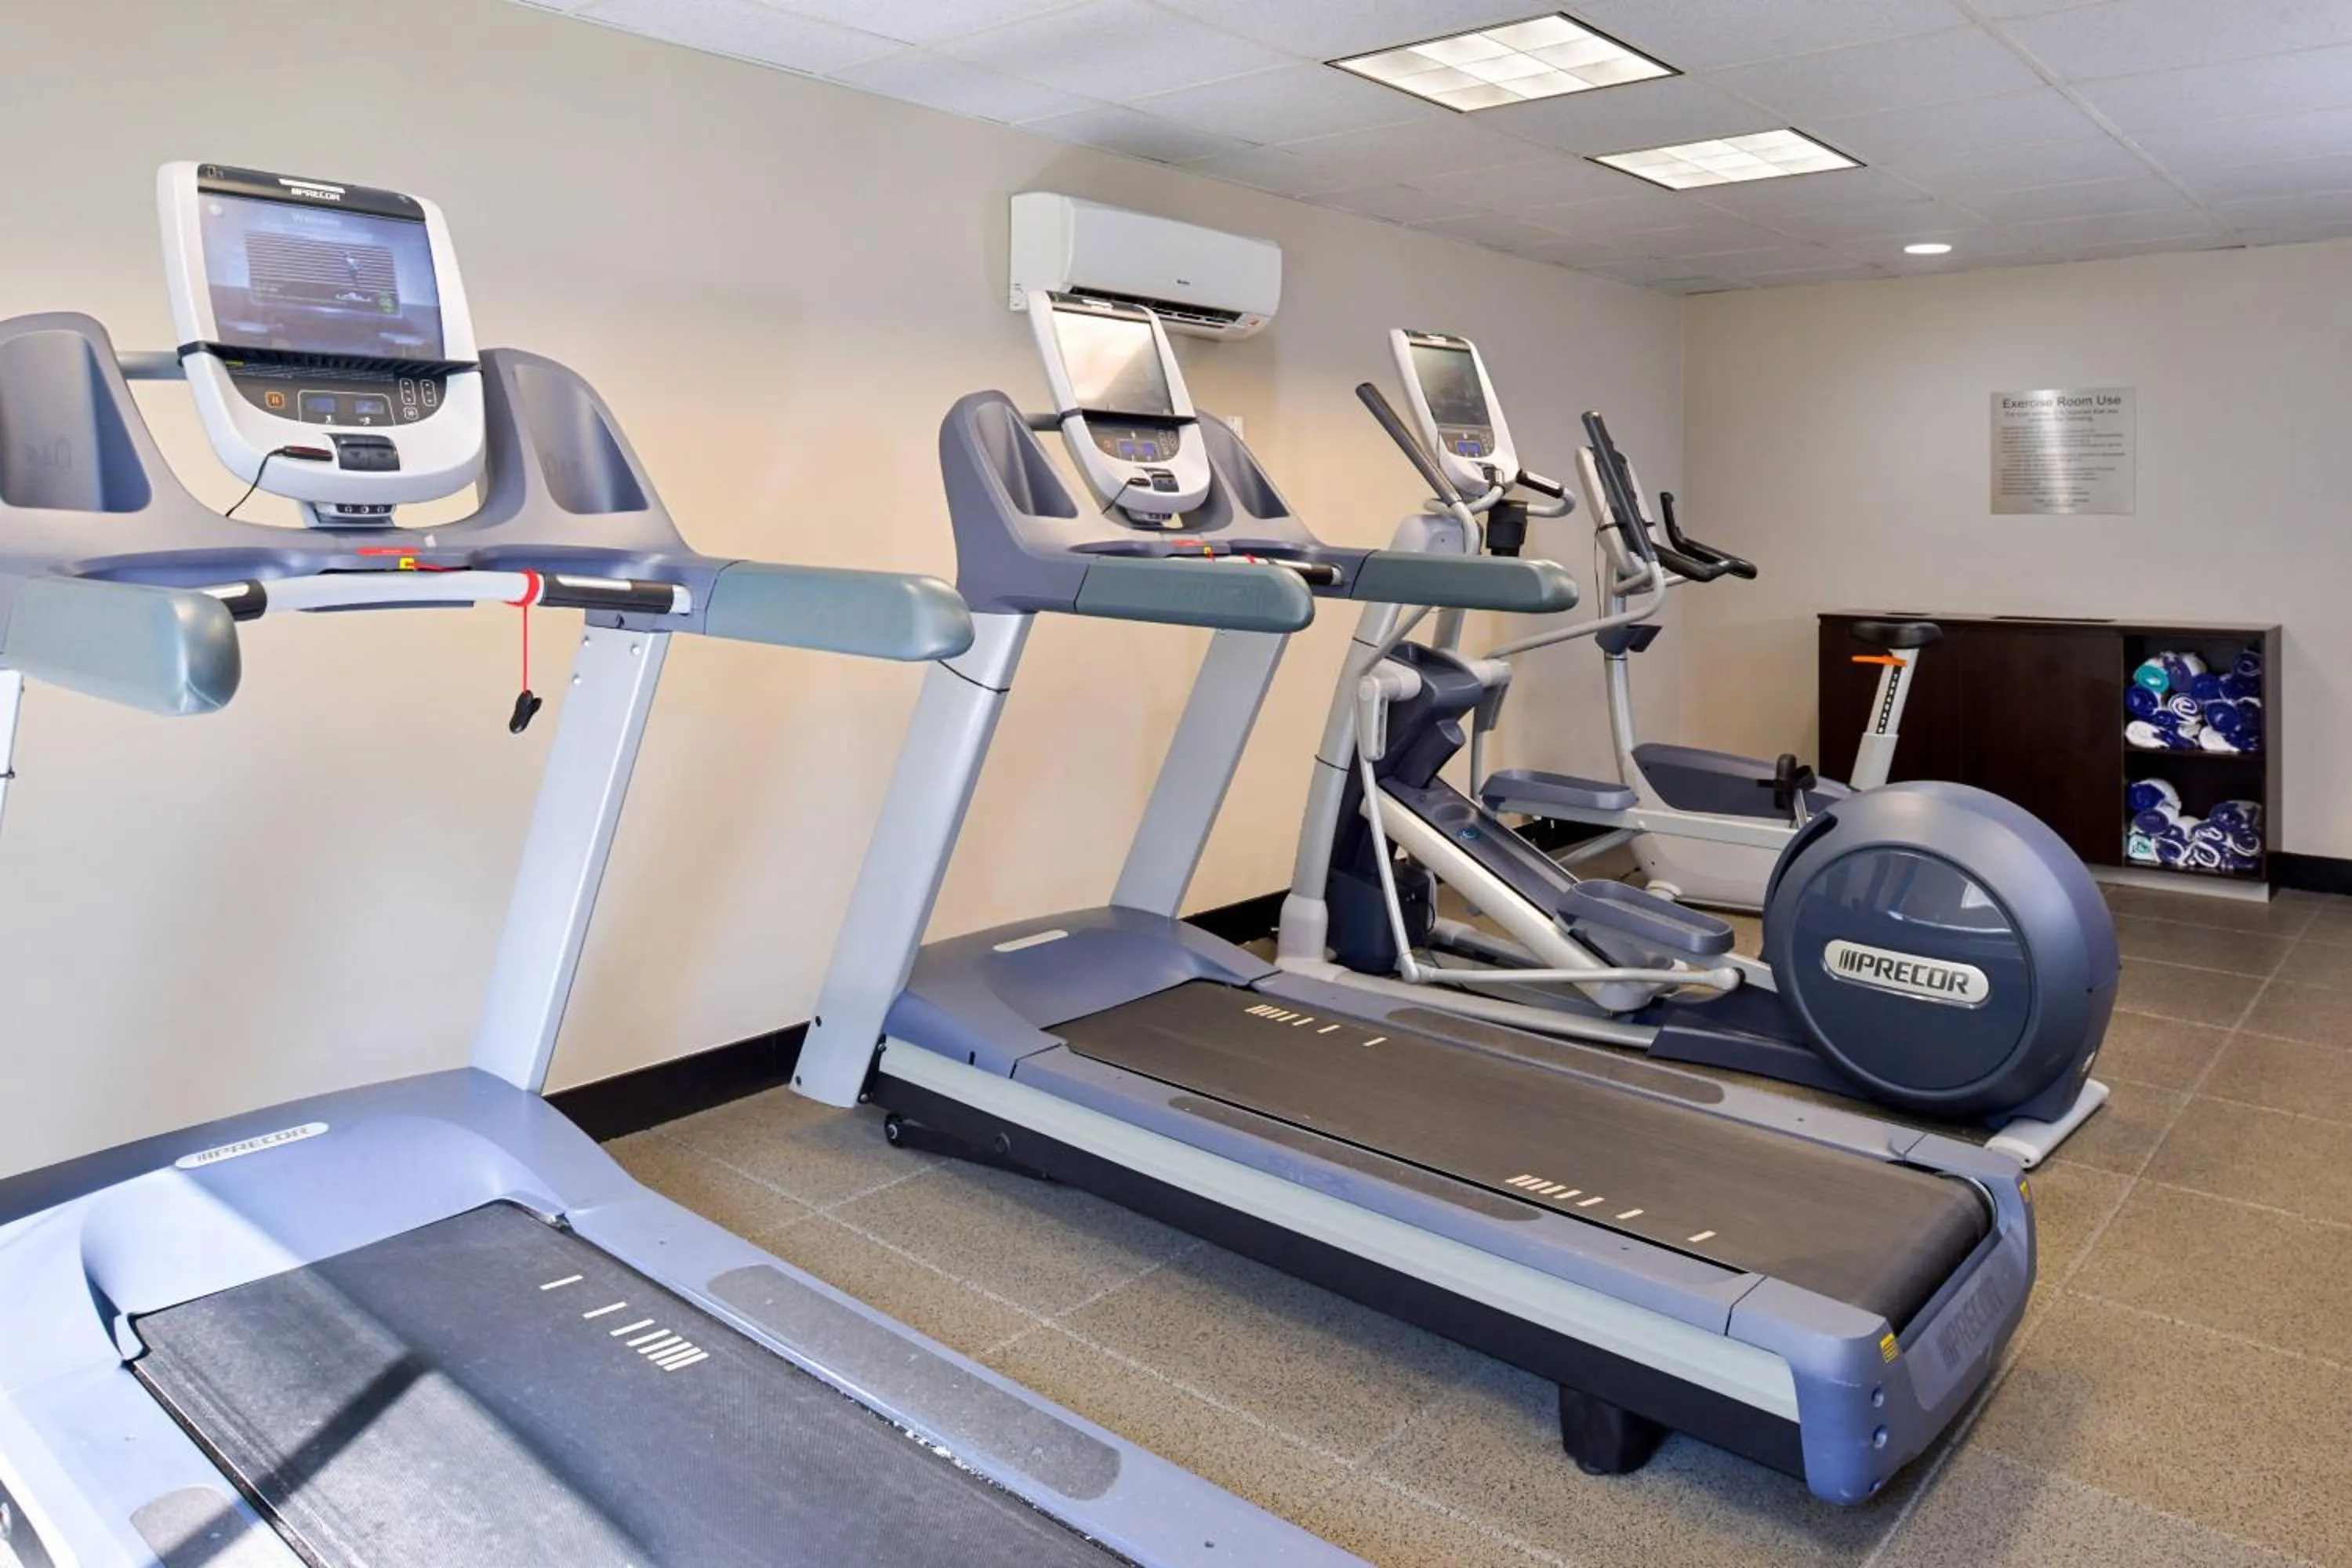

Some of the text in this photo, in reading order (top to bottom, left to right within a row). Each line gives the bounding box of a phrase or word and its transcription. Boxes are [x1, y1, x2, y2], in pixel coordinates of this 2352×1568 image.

[2002, 394, 2122, 408] Exercise Room Use
[1838, 949, 1970, 994] PRECOR
